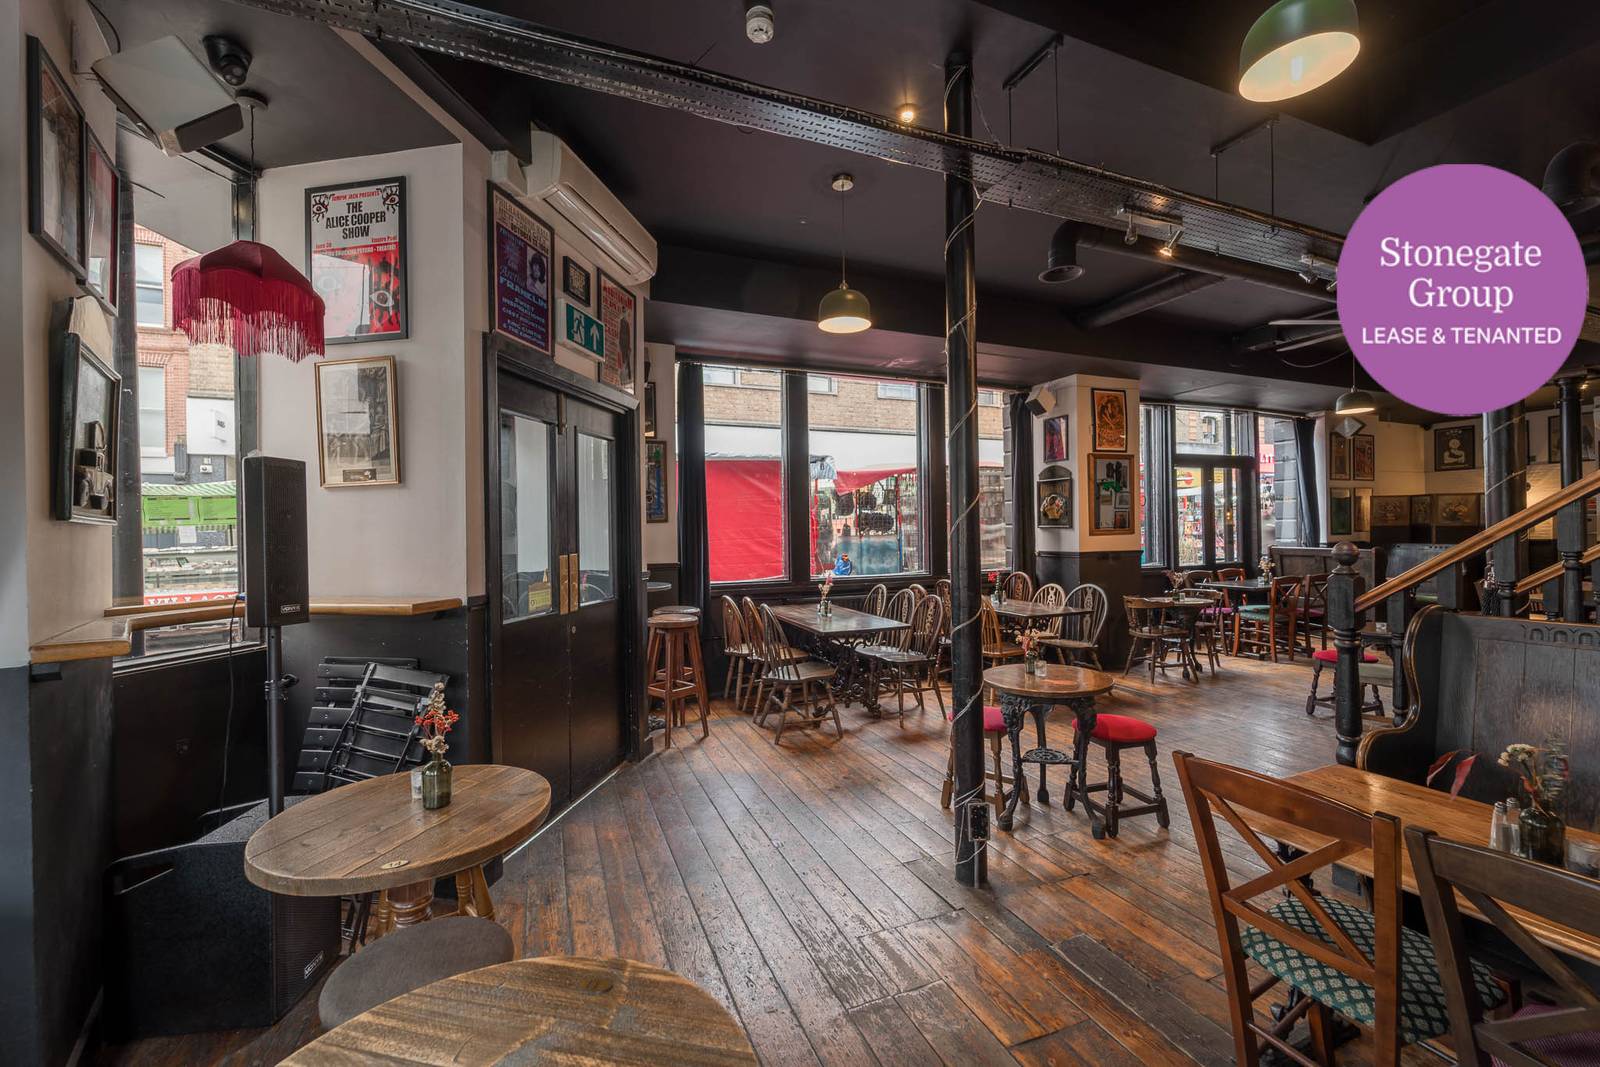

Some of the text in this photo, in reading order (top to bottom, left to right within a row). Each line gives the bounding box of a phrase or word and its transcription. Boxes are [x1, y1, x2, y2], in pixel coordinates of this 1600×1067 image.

[346, 201, 363, 214] THE
[325, 211, 386, 229] ALICE COOPER
[342, 226, 370, 240] SHOW
[499, 276, 547, 309] FRANKLIN
